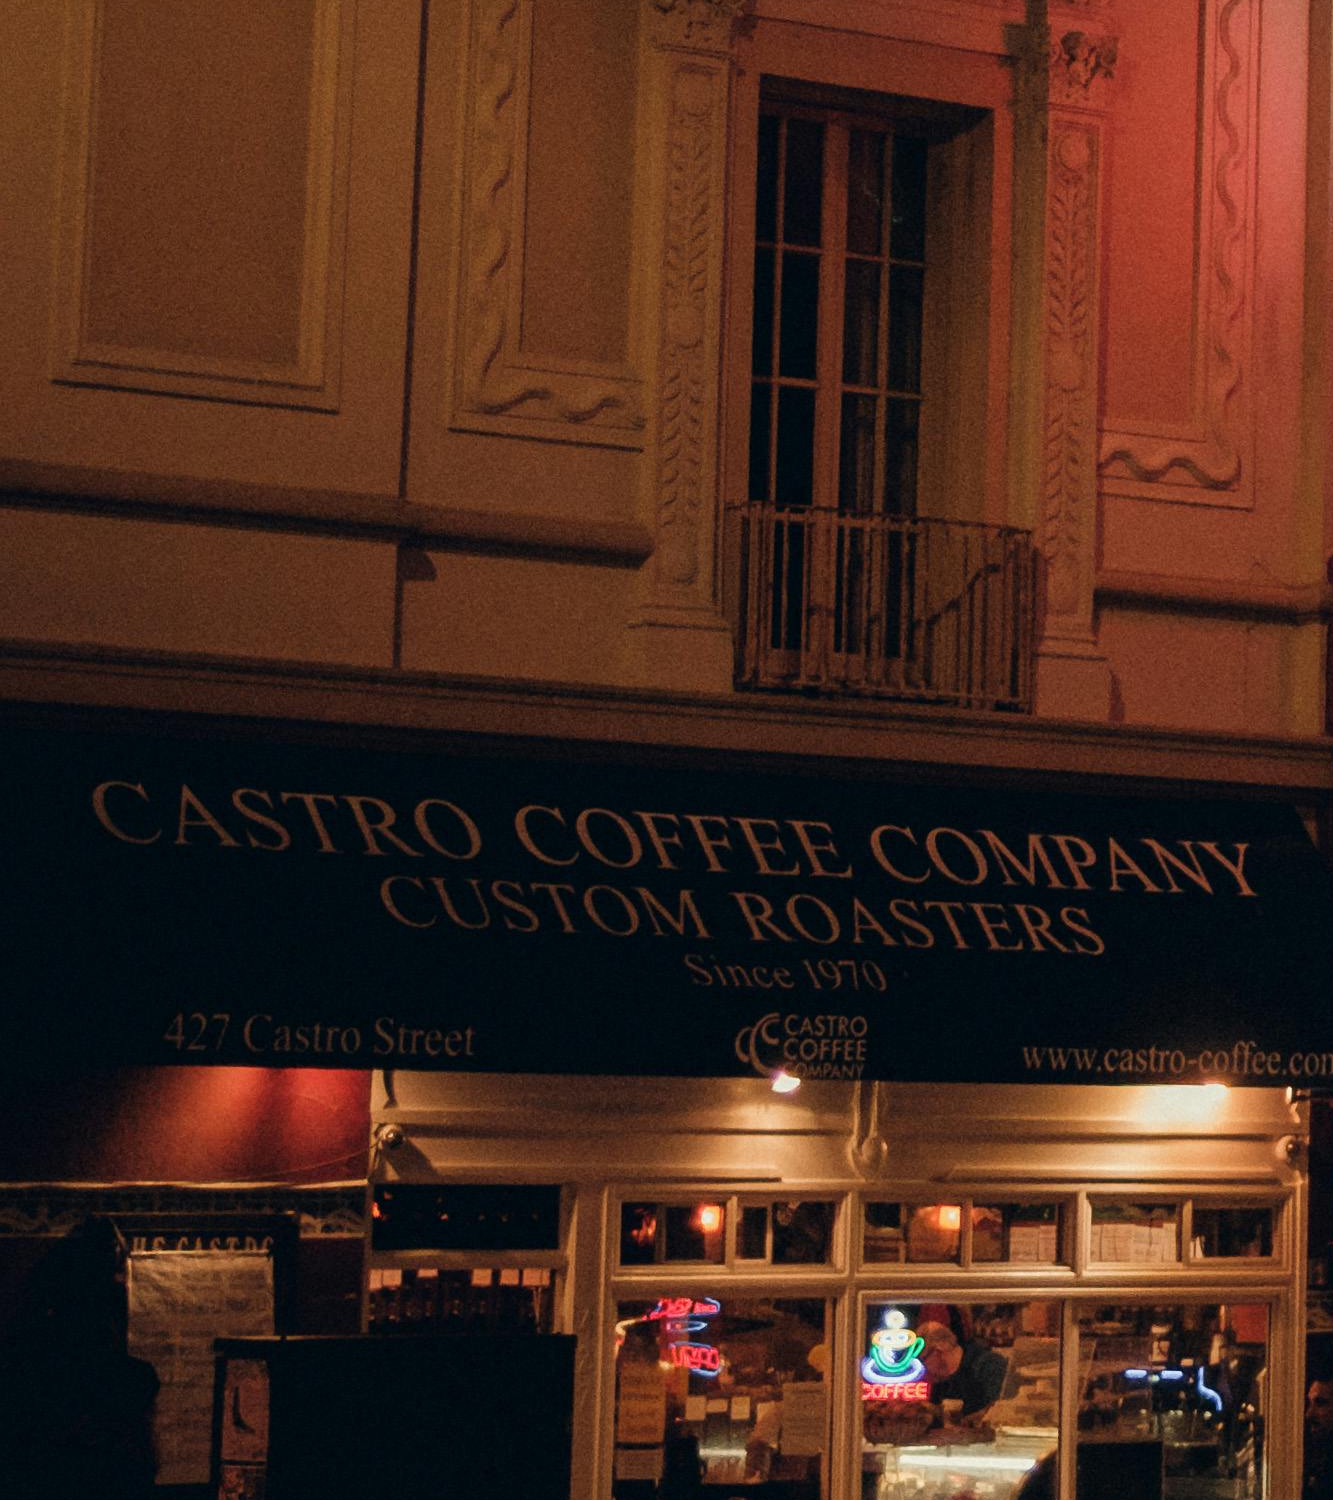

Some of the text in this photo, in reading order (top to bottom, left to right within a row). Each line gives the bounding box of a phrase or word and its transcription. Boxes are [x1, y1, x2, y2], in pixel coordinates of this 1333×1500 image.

[91, 780, 1258, 898] CASTRO COFFEE COMPANY
[379, 874, 1106, 956] CUSTOM ROASTERS
[682, 953, 888, 992] Since 1970
[162, 1010, 477, 1056] 427 Castro Street
[784, 1013, 869, 1037] CASTRO
[783, 1037, 868, 1061] COFFEE
[784, 1062, 866, 1079] COMPANY
